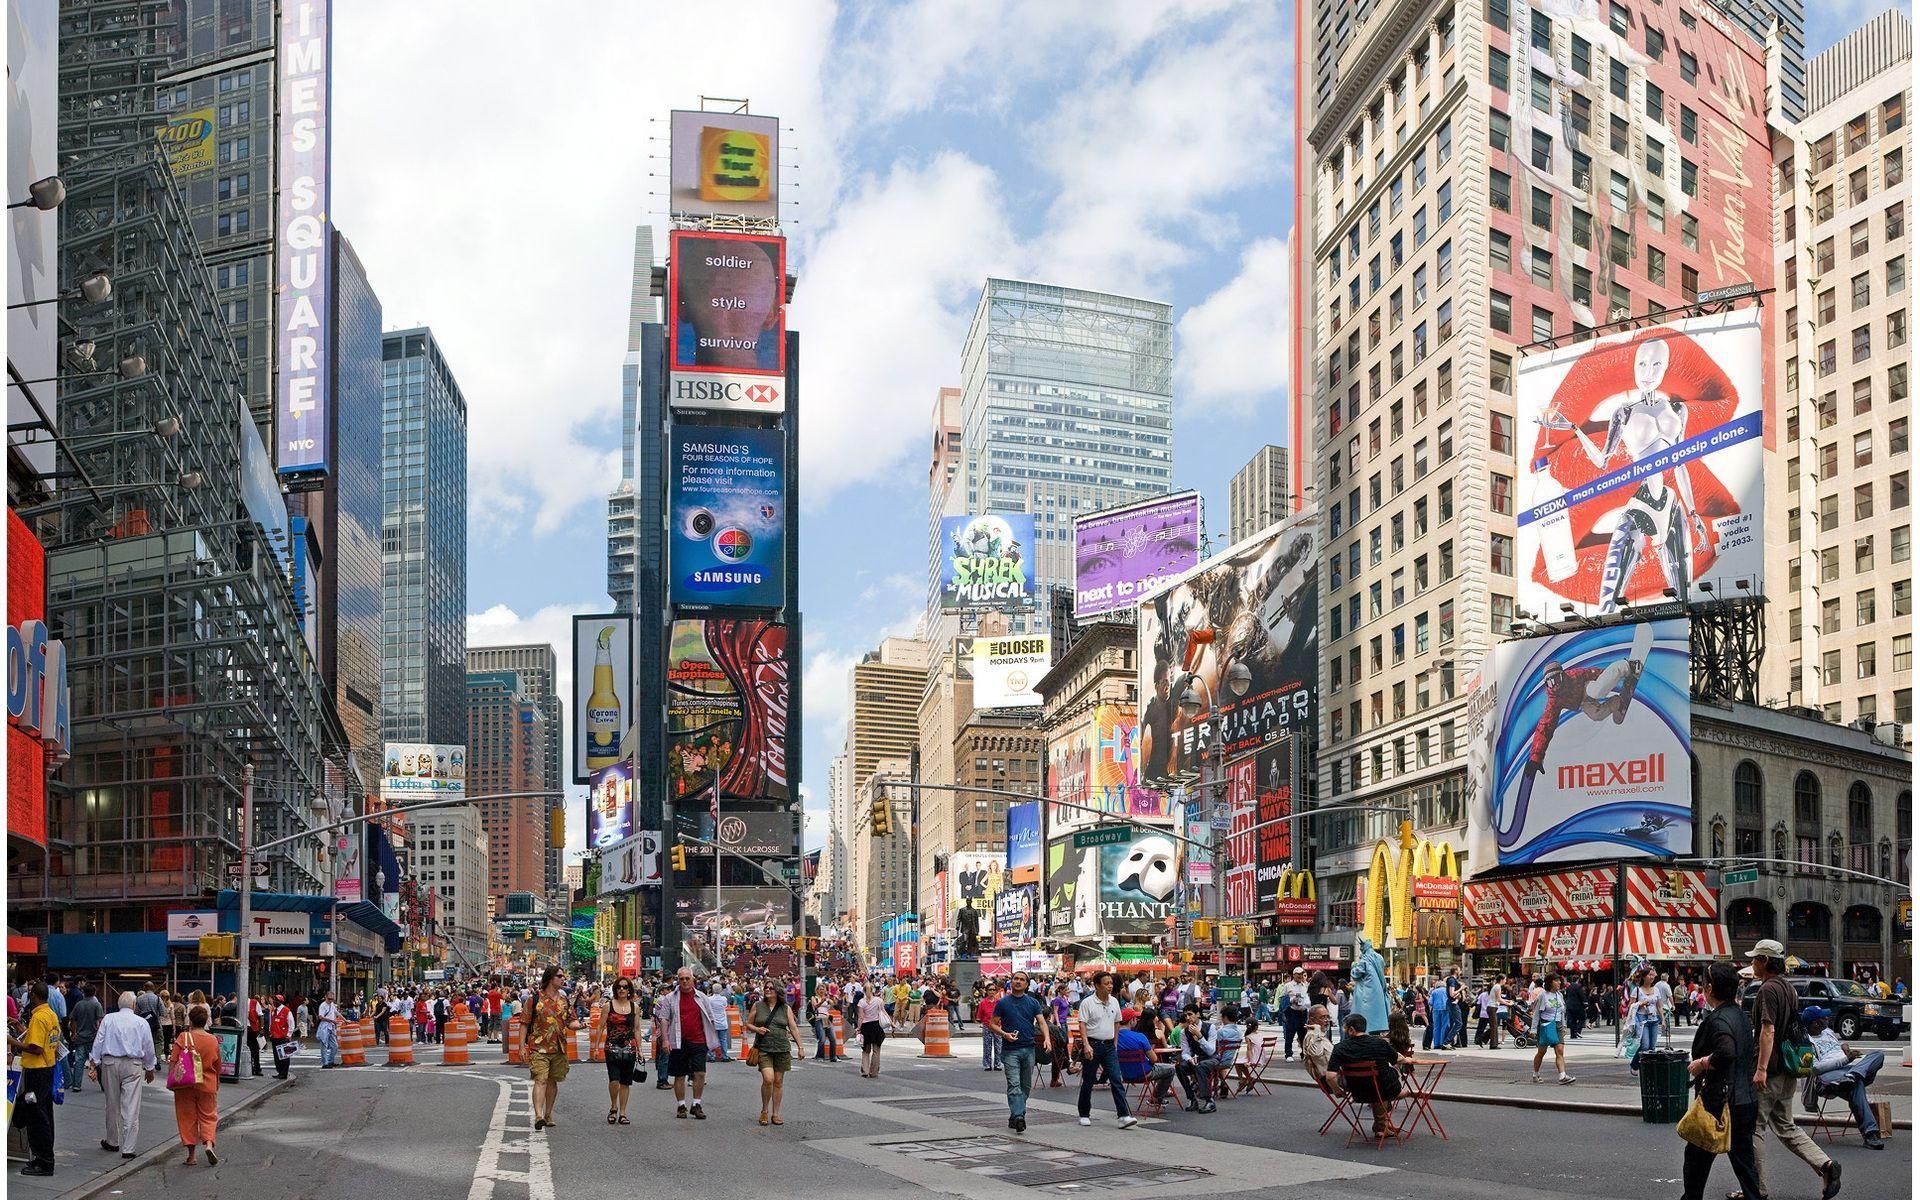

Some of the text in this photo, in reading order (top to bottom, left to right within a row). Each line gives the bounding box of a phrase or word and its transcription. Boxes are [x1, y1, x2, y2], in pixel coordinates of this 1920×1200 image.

[286, 3, 323, 412] IMES SQUARE
[706, 255, 752, 269] soldier
[711, 297, 746, 310] style
[700, 337, 758, 350] survivor
[676, 380, 742, 402] HSBC
[289, 438, 314, 452] NYC
[683, 442, 750, 455] SAMSUNG'S
[704, 455, 740, 463] SEASONS
[682, 465, 776, 478] For more information
[1533, 426, 1749, 518] SVEDKA man cannot live on gossip alone.
[682, 475, 733, 485] please visit
[1542, 515, 1565, 528] VODKA
[1717, 514, 1752, 528] voted #1
[1724, 525, 1749, 537] vodka
[1721, 535, 1754, 551] of 2033.
[694, 571, 761, 584] SAMSUNG
[952, 556, 1027, 585] SHREK
[1078, 582, 1113, 604] next
[1116, 580, 1134, 596] to
[998, 639, 1044, 656] CLOSER
[681, 660, 710, 670] Open
[668, 669, 726, 680] Happiness
[589, 709, 618, 719] Corona
[1171, 686, 1317, 748] TERINATO
[1184, 706, 1308, 755] SAVATION
[1238, 736, 1262, 748] BACK
[1265, 727, 1290, 741] 05.21
[1558, 753, 1665, 789] maxell
[1260, 786, 1290, 806] BROAD
[1587, 785, 1665, 797] www.maxell.com
[1261, 801, 1290, 821] WAY'S
[1261, 820, 1290, 840] SURE
[1080, 832, 1122, 845] Broadway
[743, 845, 780, 853] LACROSSE
[1261, 837, 1290, 862] THING
[1738, 874, 1748, 882] Av
[1416, 882, 1458, 891] McDonald's
[1523, 896, 1548, 906] FRIDAY'S
[1098, 901, 1176, 919] PHANT
[268, 927, 305, 935] TISHMAN
[623, 943, 634, 967] tkts
[900, 945, 912, 968] tkts
